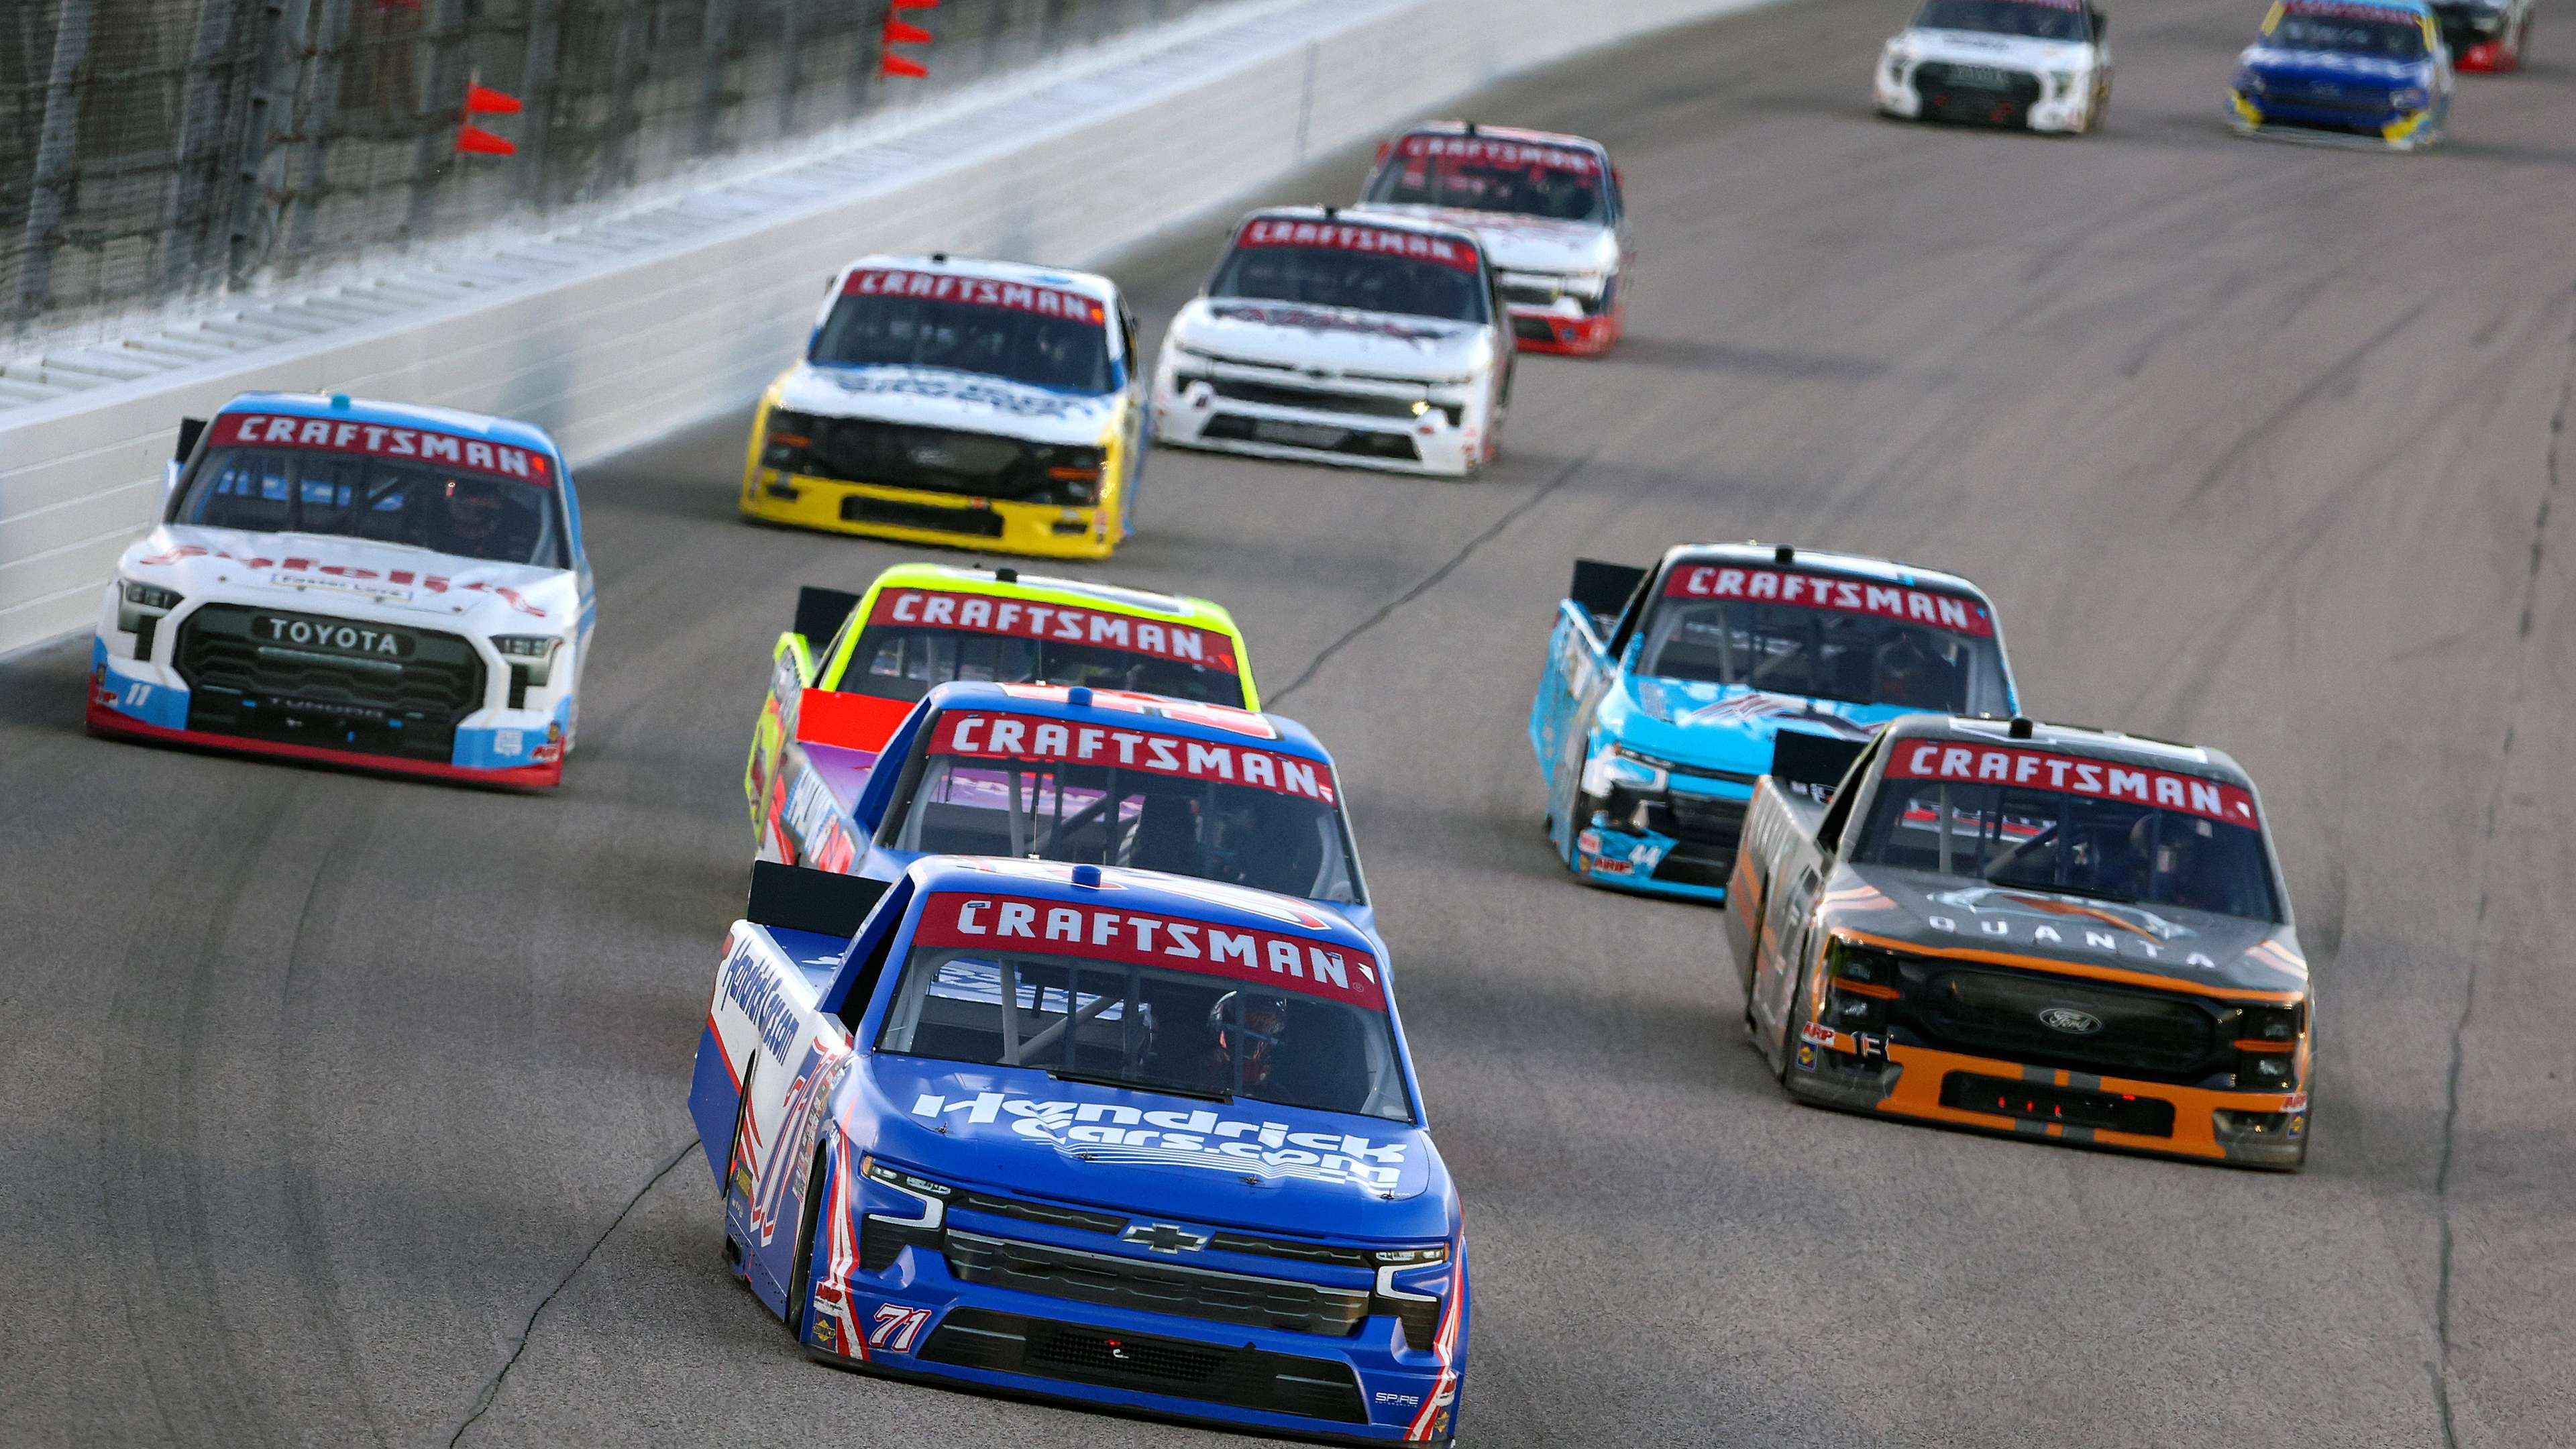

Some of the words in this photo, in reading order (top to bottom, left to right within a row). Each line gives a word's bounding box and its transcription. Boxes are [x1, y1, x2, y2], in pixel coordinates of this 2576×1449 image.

[1251, 221, 1454, 259] CRAFTSMAN
[861, 270, 1087, 319] CRAFTSMAN
[237, 416, 529, 478] CRAFTSMAN
[892, 593, 1204, 661] CRAFTSMAN
[1688, 568, 1968, 629] CRAFTSMAN
[270, 618, 398, 655] TOYOTA
[953, 717, 1320, 800] CRAFTSMAN
[1910, 745, 2222, 814] CRAFTSMAN
[957, 899, 1350, 989] CRAFTSMAN
[1929, 915, 2215, 969] QUANTA
[911, 1091, 1407, 1163] Hendrick
[1011, 1116, 1401, 1197] Cars.com
[869, 1302, 932, 1353] 71
[1375, 1391, 1420, 1405] SPIRE
